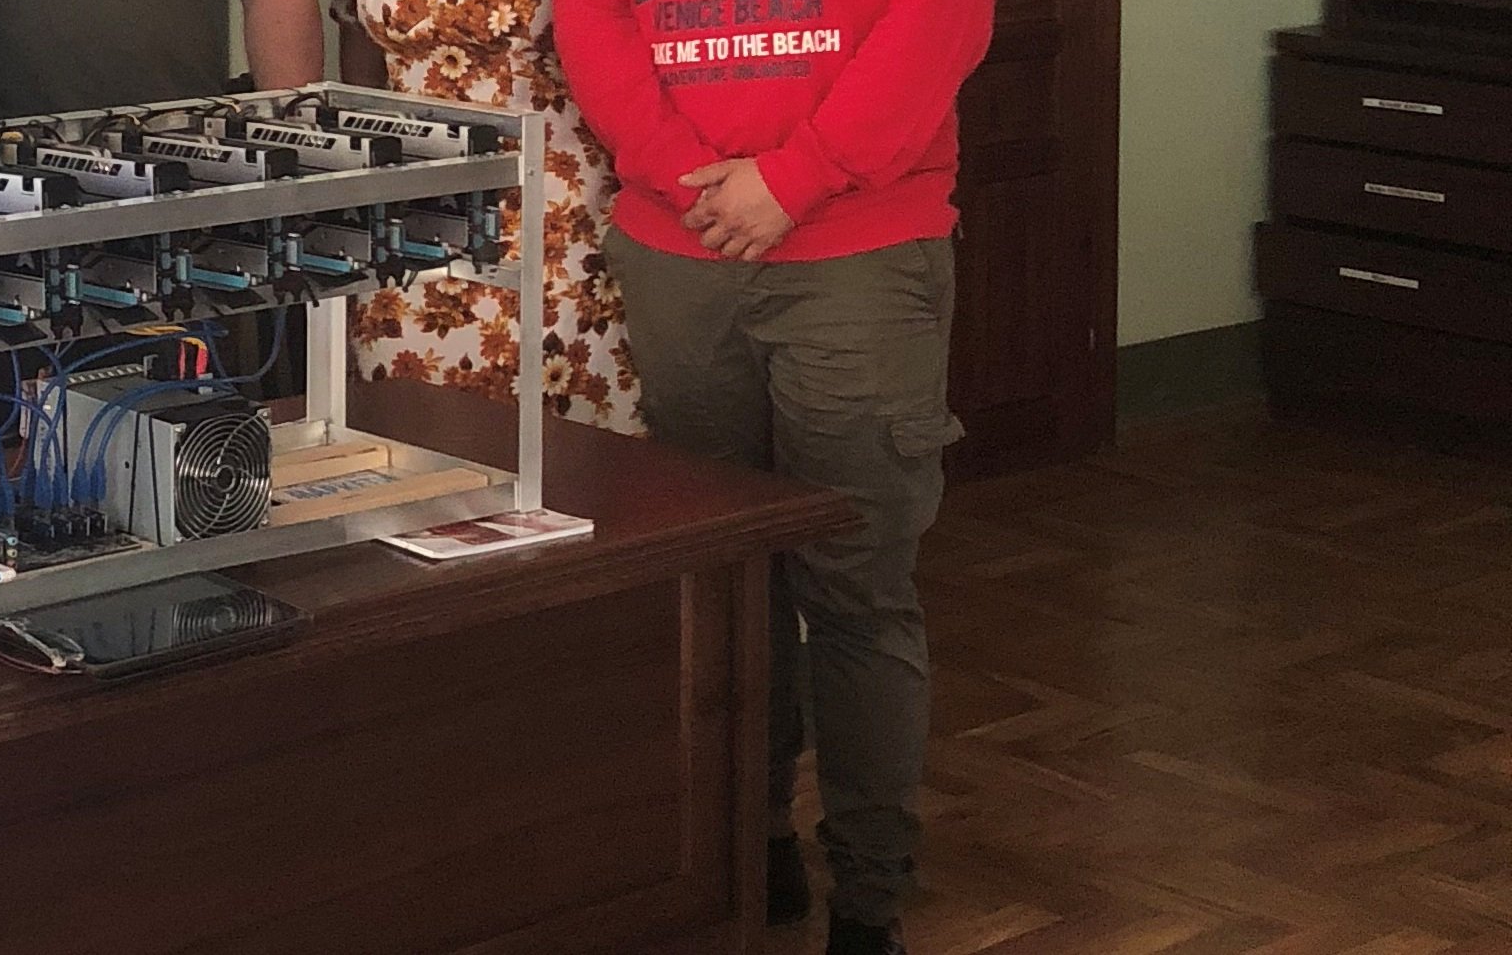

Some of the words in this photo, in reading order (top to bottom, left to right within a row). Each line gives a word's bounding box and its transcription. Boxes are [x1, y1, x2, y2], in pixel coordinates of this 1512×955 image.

[676, 39, 701, 64] ME
[704, 37, 729, 61] TO
[732, 33, 769, 58] THE
[772, 29, 841, 56] BEACH
